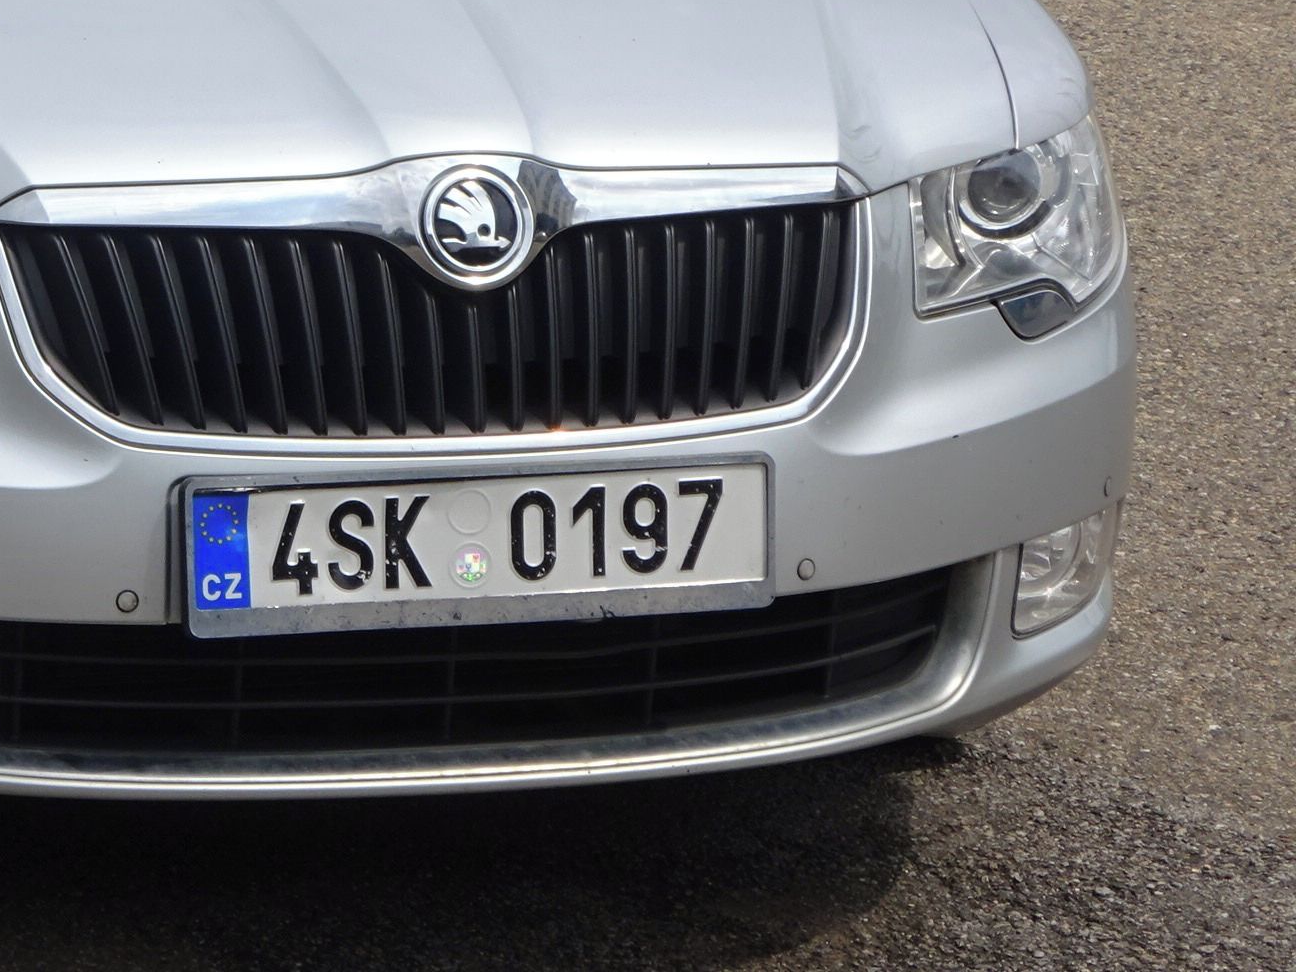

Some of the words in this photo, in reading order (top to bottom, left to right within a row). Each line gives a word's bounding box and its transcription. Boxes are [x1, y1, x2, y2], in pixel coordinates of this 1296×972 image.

[271, 494, 433, 596] 4SK
[509, 477, 724, 583] 0197
[202, 572, 243, 602] CZ
